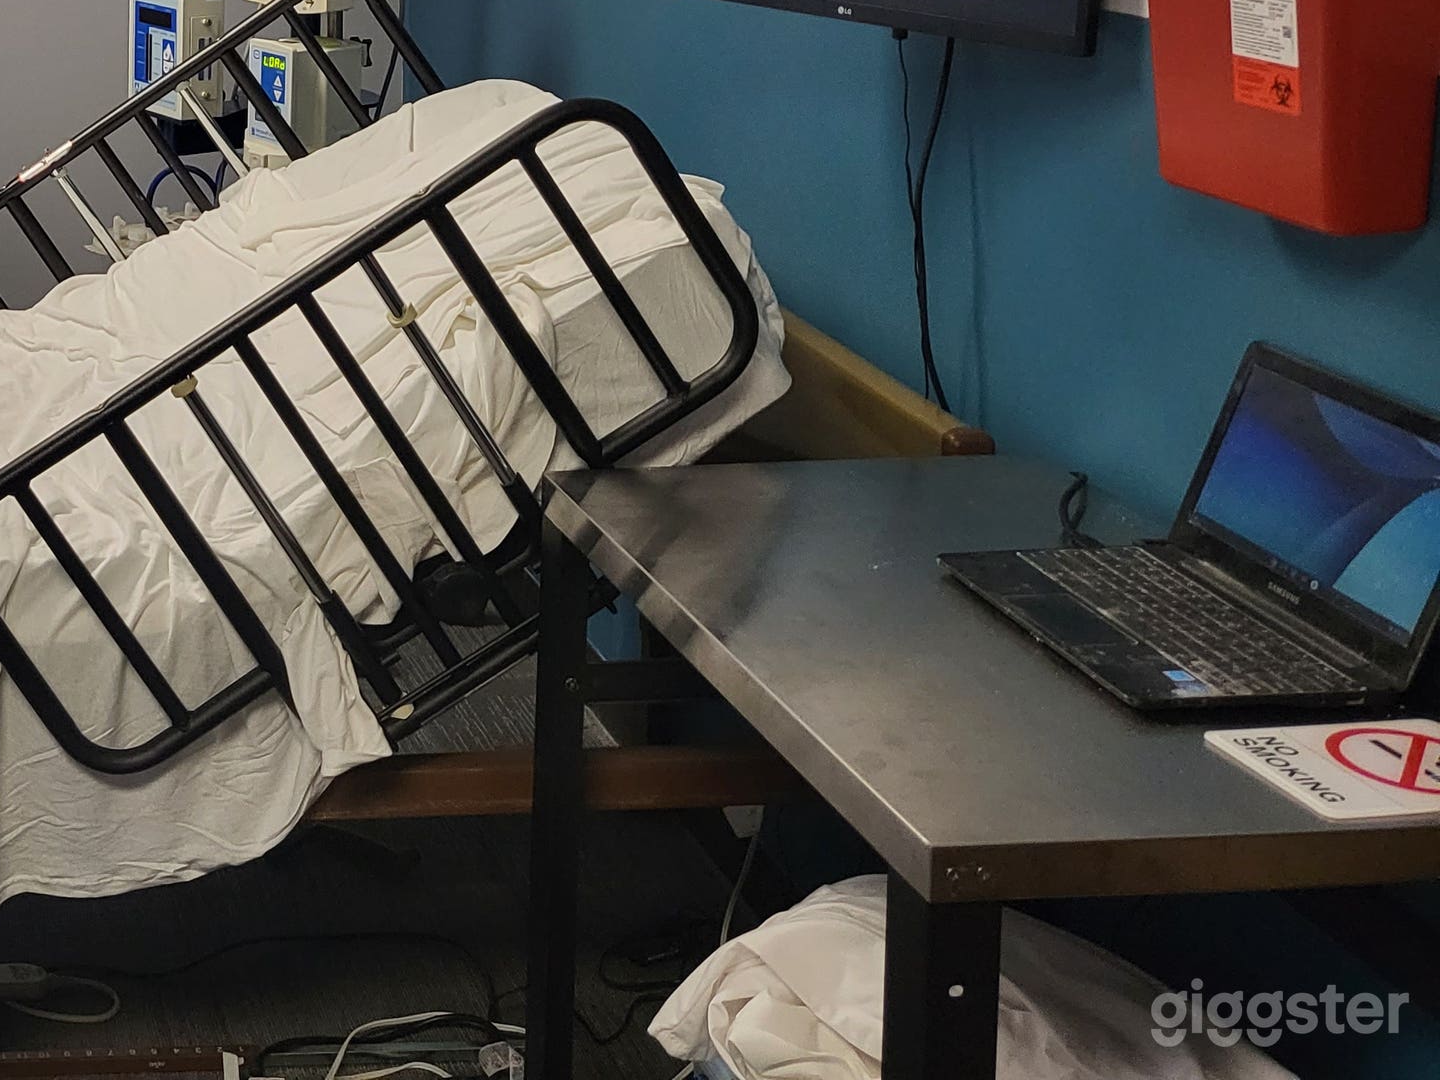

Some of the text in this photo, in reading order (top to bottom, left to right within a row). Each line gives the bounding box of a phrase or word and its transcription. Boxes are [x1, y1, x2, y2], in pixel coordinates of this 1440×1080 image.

[1267, 581, 1301, 605] SAMSUNG
[1256, 735, 1299, 757] NO
[1233, 736, 1346, 803] SMOKING
